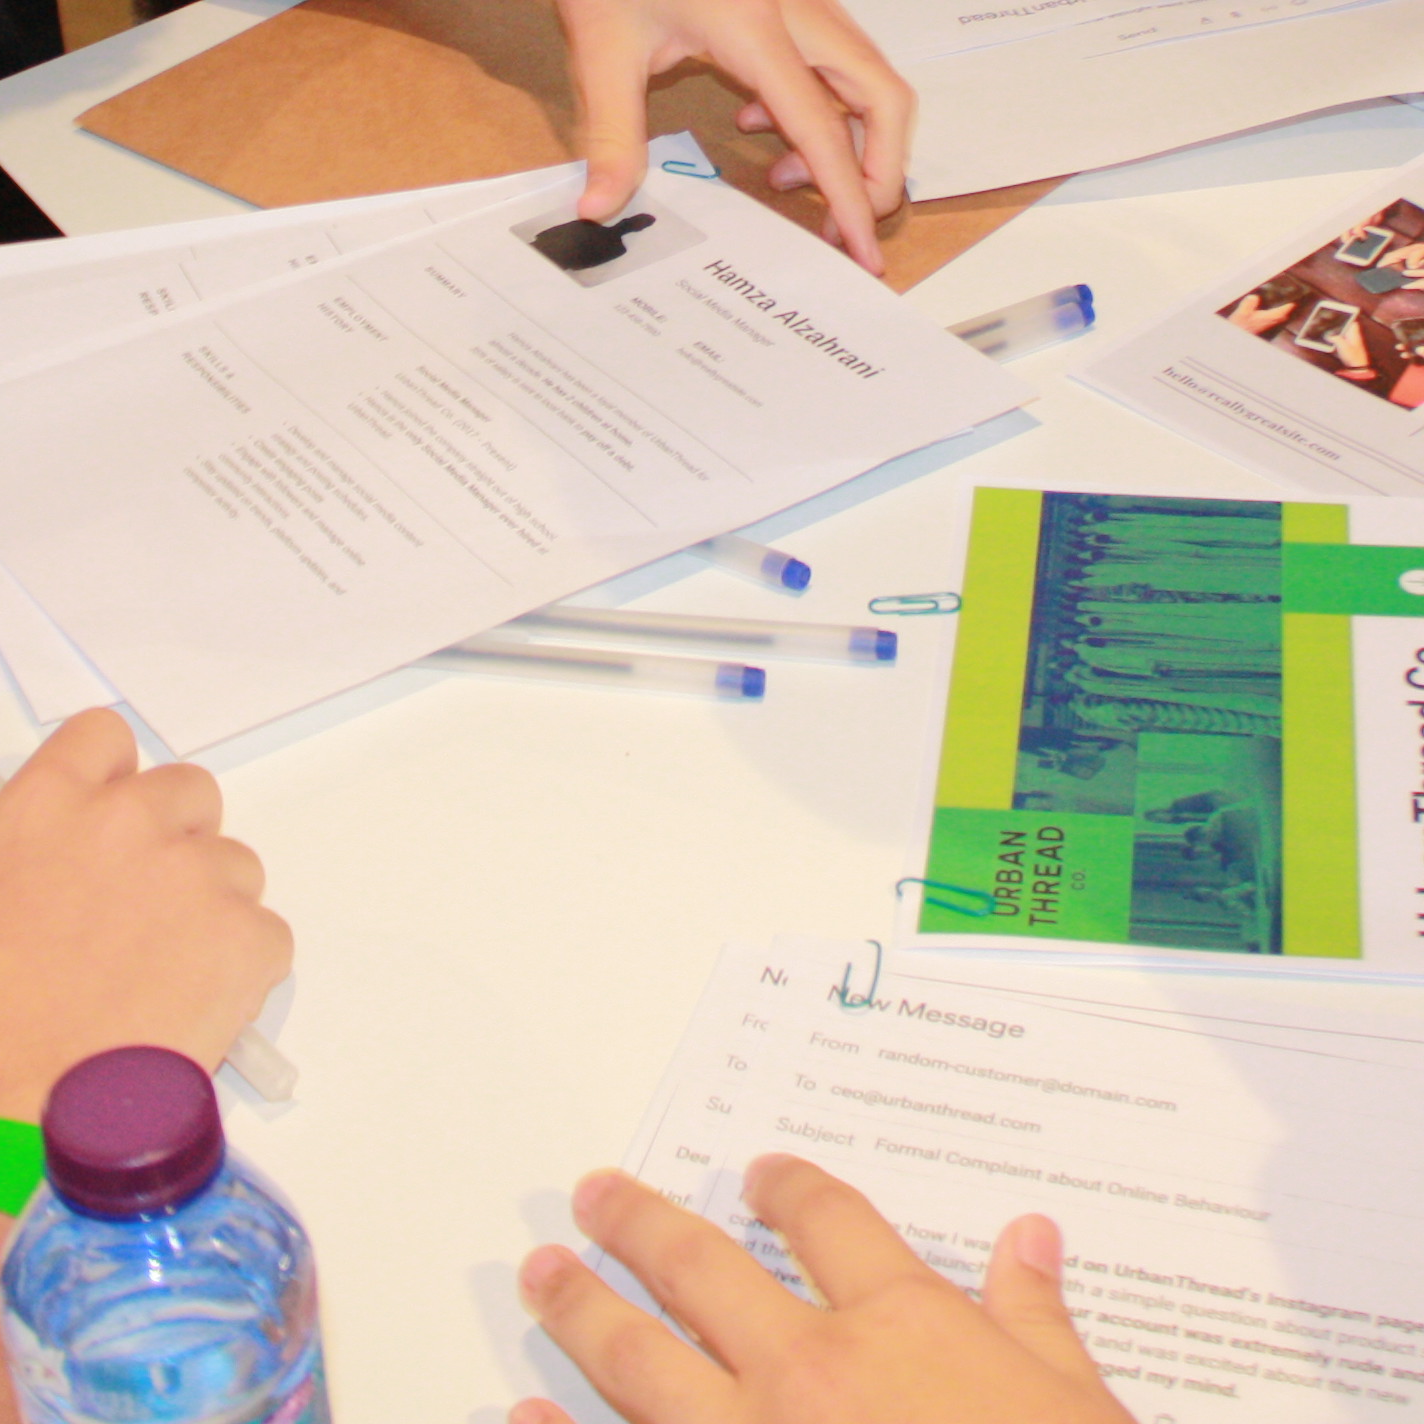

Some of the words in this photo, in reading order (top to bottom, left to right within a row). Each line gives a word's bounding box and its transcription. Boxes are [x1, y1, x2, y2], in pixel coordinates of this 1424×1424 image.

[701, 259, 778, 310] Hamza
[771, 306, 884, 383] Alzahrani
[992, 830, 1027, 917] URBAN
[1028, 826, 1065, 926] THREAD
[826, 984, 893, 1013] New
[895, 998, 1027, 1043] Message
[791, 1072, 818, 1092] To
[827, 1081, 1044, 1137] ceo@urbanthread.com
[808, 1031, 862, 1054] From
[876, 1045, 1178, 1117] random-customer@domain.com
[672, 1145, 714, 1166] Dea
[773, 1115, 857, 1149] Subject
[874, 1136, 941, 1160] Formal
[943, 1149, 1043, 1183] Complaint
[1047, 1169, 1103, 1191] about
[1105, 1180, 1170, 1204] Online
[1172, 1192, 1271, 1223] Behaviour
[1083, 1256, 1107, 1274] on
[1266, 1292, 1369, 1326] Instagram
[1107, 1285, 1175, 1314] simple
[1180, 1300, 1267, 1332] question
